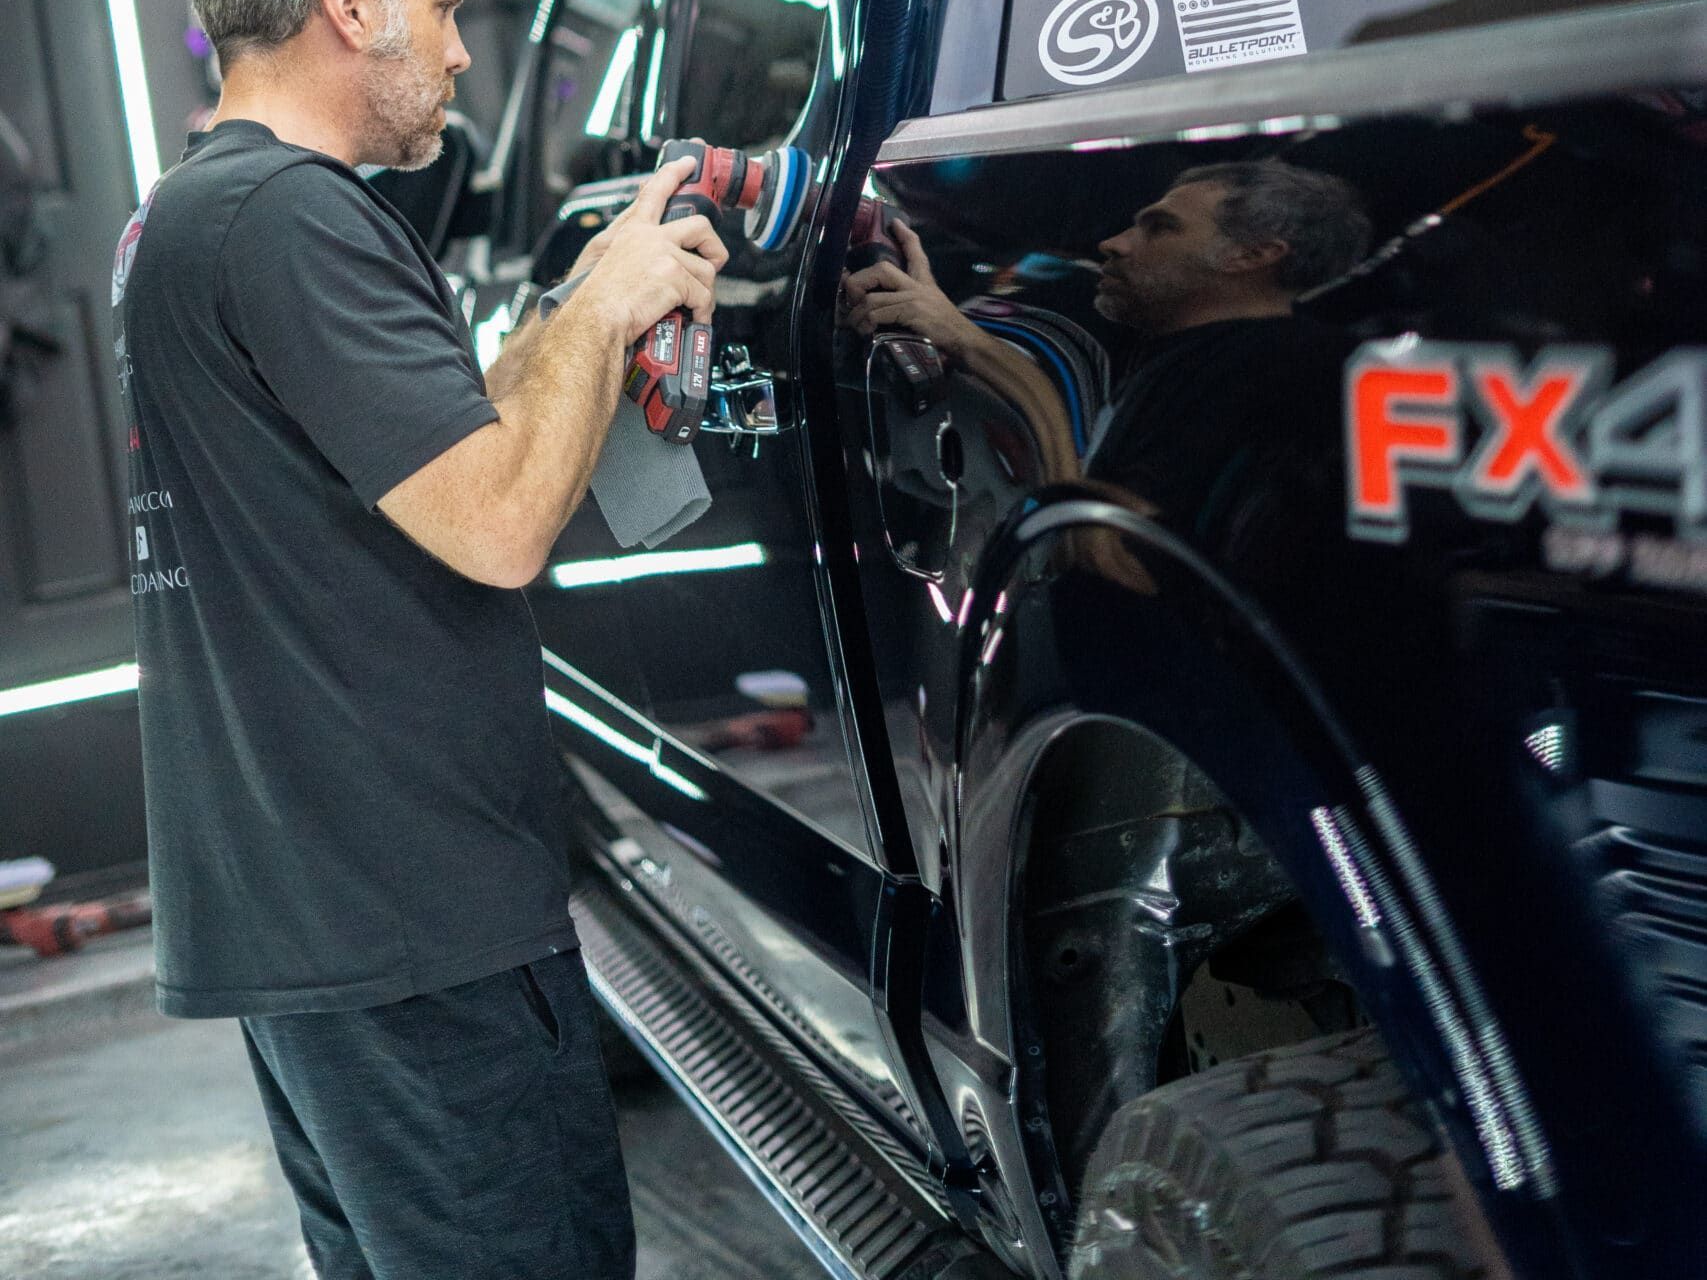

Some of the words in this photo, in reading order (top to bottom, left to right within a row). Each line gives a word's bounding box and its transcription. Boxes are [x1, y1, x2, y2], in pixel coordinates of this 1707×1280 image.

[1188, 32, 1297, 60] BULLETPOINT
[1188, 54, 1238, 66] MOUNTING
[1243, 43, 1297, 57] SOLUTIONS
[697, 335, 707, 353] FLEX
[693, 372, 704, 388] 12V
[1344, 338, 1707, 544] FX4
